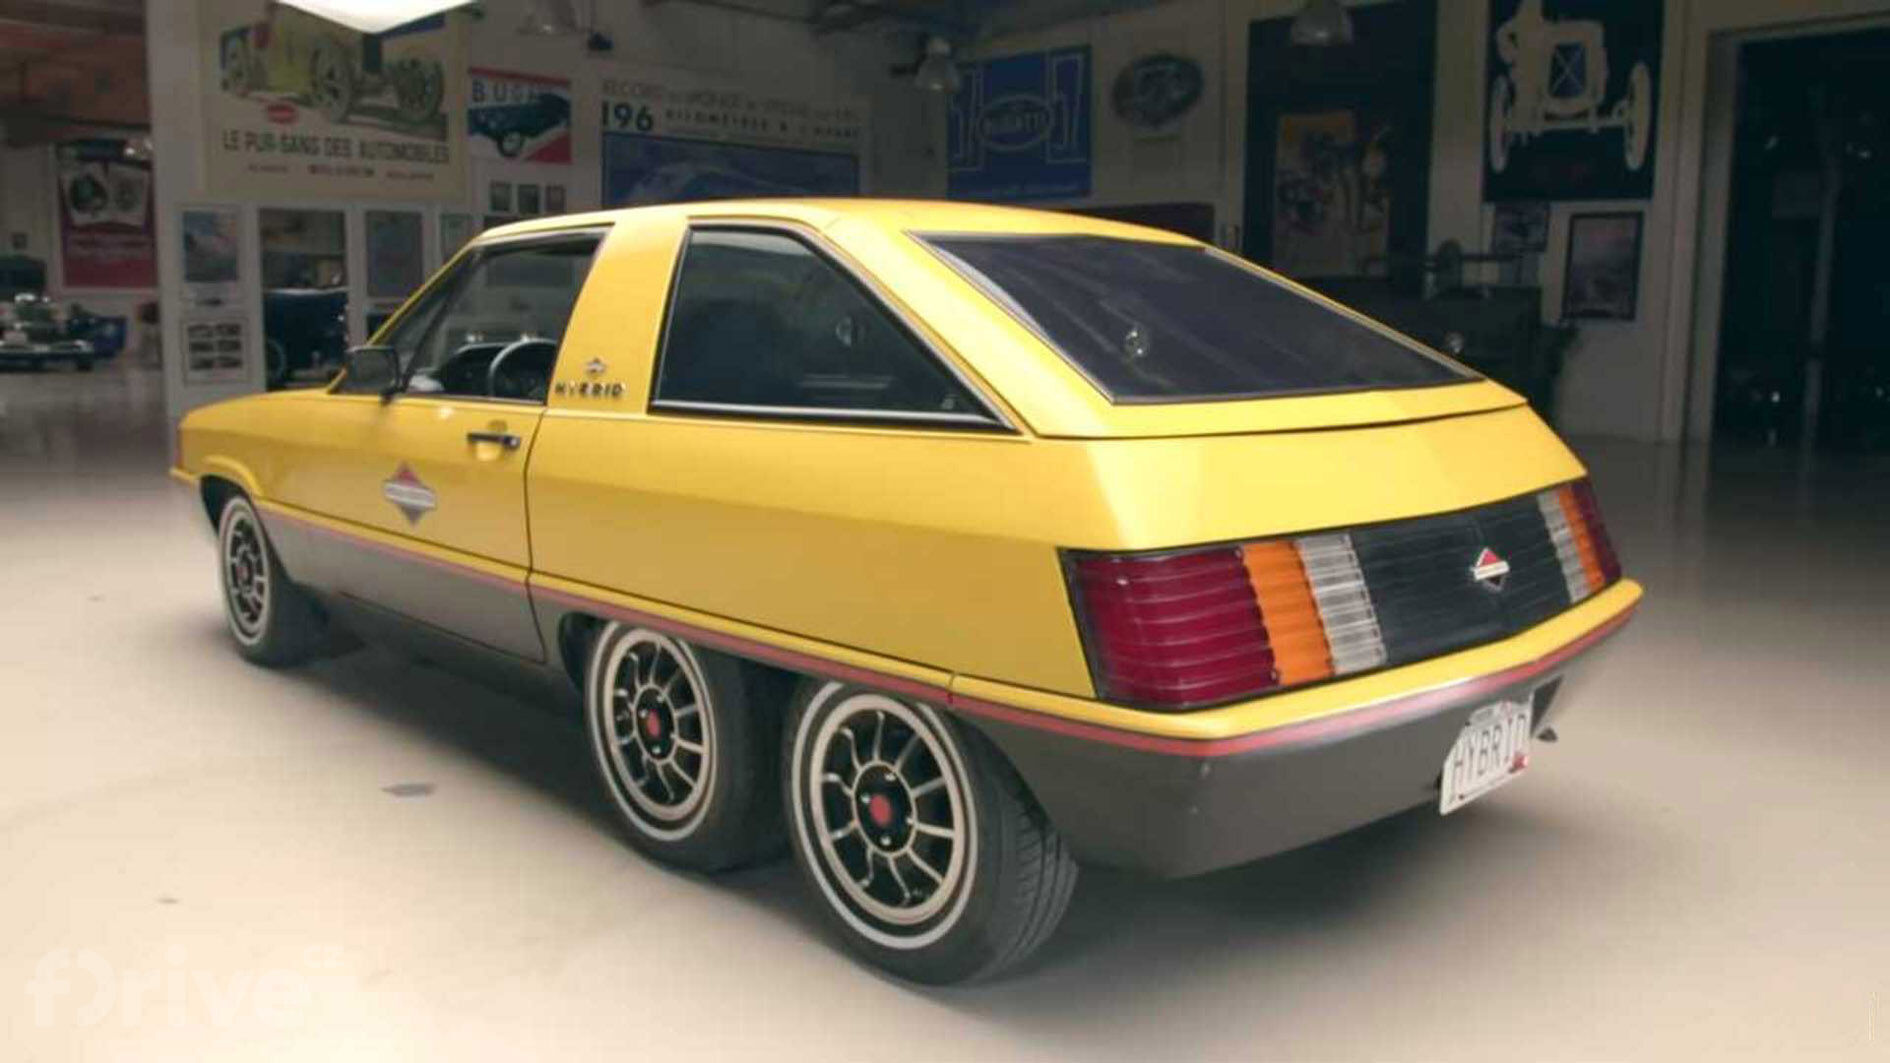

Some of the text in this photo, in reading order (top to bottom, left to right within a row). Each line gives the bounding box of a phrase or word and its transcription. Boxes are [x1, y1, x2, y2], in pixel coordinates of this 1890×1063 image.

[601, 101, 655, 132] 196
[222, 129, 240, 151] LE
[323, 136, 352, 158] DES
